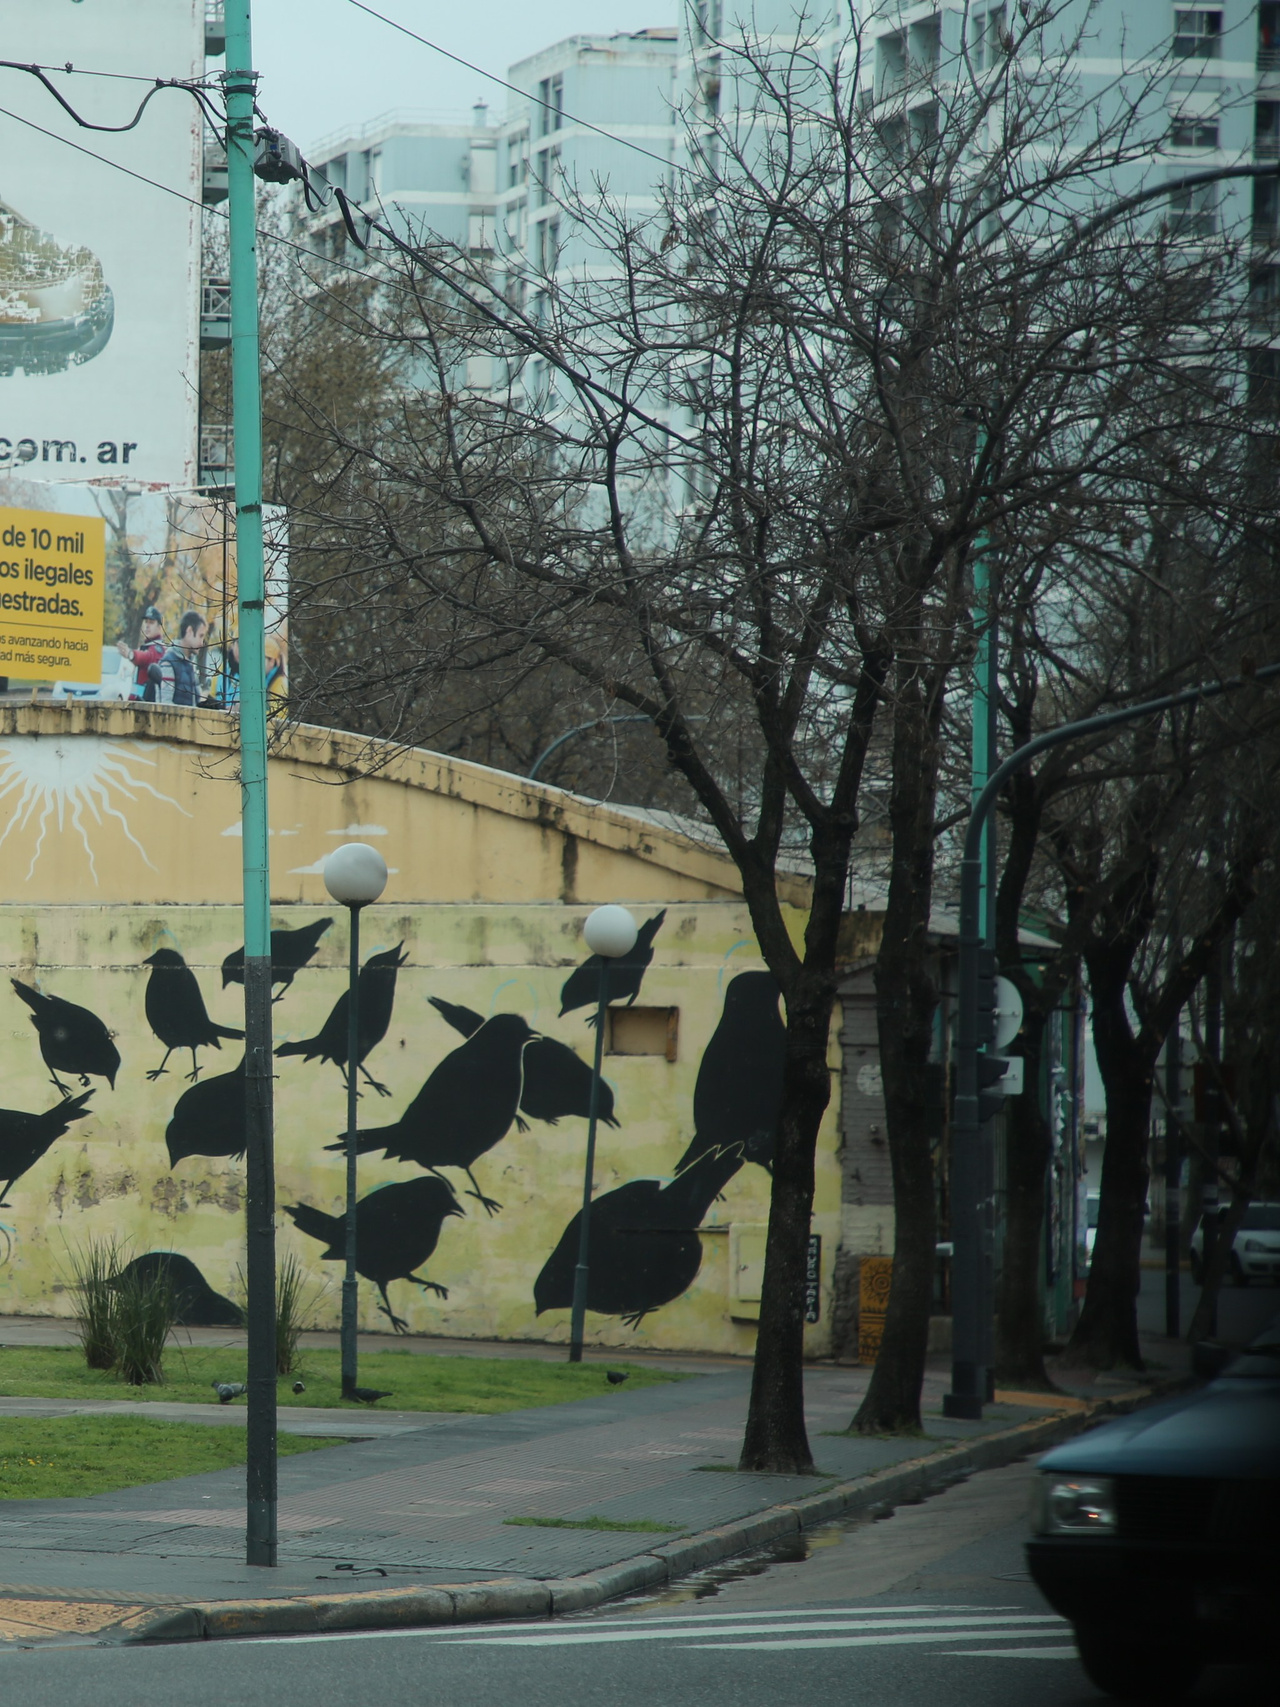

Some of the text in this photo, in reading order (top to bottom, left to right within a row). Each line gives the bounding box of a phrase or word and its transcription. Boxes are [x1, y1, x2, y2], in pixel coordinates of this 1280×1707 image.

[2, 524, 26, 548] de
[31, 528, 51, 550] 10
[57, 532, 84, 554] mil
[24, 558, 93, 587] ilegales
[8, 635, 61, 650] avanzando
[63, 638, 89, 652] hacia
[15, 651, 36, 663] más
[37, 655, 72, 668] segura.
